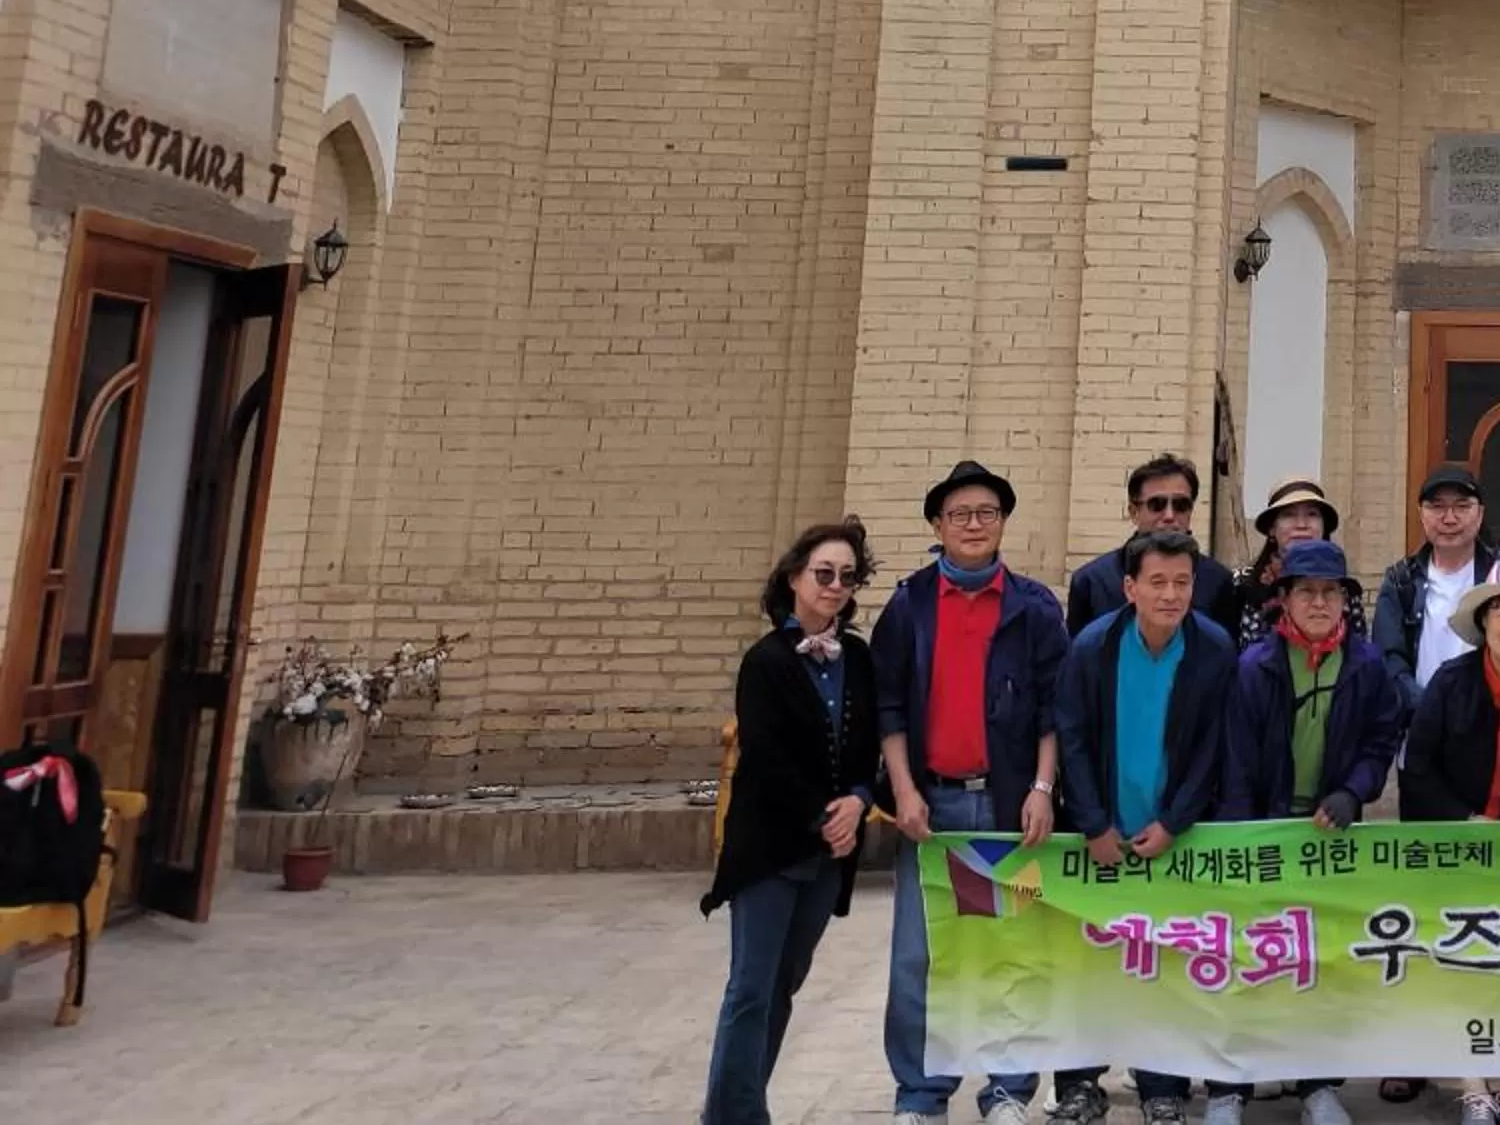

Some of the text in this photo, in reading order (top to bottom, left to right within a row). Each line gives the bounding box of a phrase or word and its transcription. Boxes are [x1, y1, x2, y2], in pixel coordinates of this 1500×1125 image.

[1165, 843, 1285, 884] 세계화를
[1298, 839, 1358, 876] 위한
[1373, 839, 1493, 870] 미술단체
